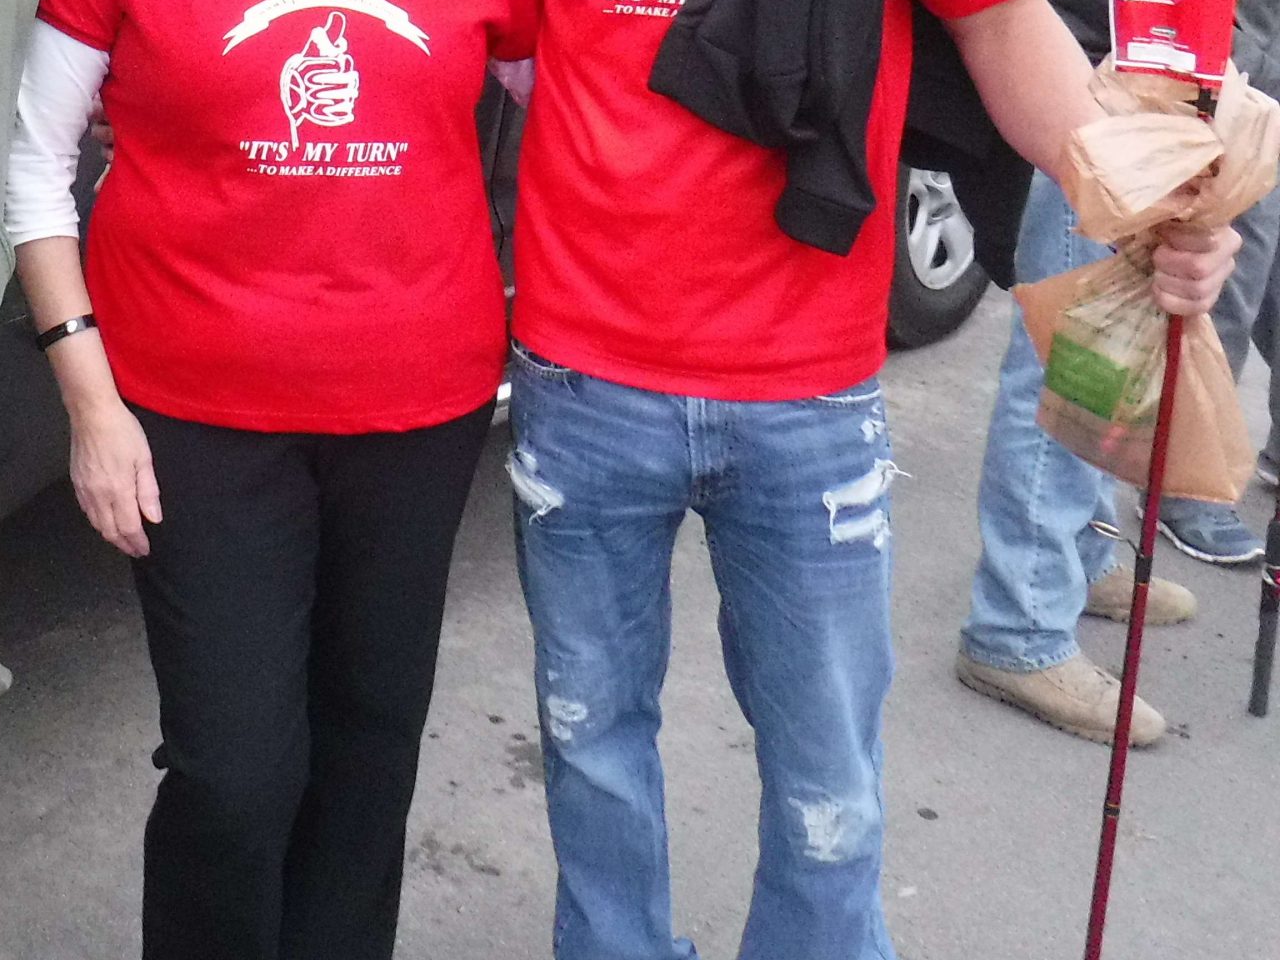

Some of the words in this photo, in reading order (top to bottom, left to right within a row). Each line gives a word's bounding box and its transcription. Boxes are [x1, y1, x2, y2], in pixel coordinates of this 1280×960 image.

[635, 5, 670, 17] MAKE
[239, 140, 290, 161] "IT'S
[302, 142, 339, 162] MY
[346, 142, 408, 163] TURN"
[278, 165, 314, 176] MAKE
[314, 166, 324, 175] A
[325, 165, 402, 177] DIFFERENCE
